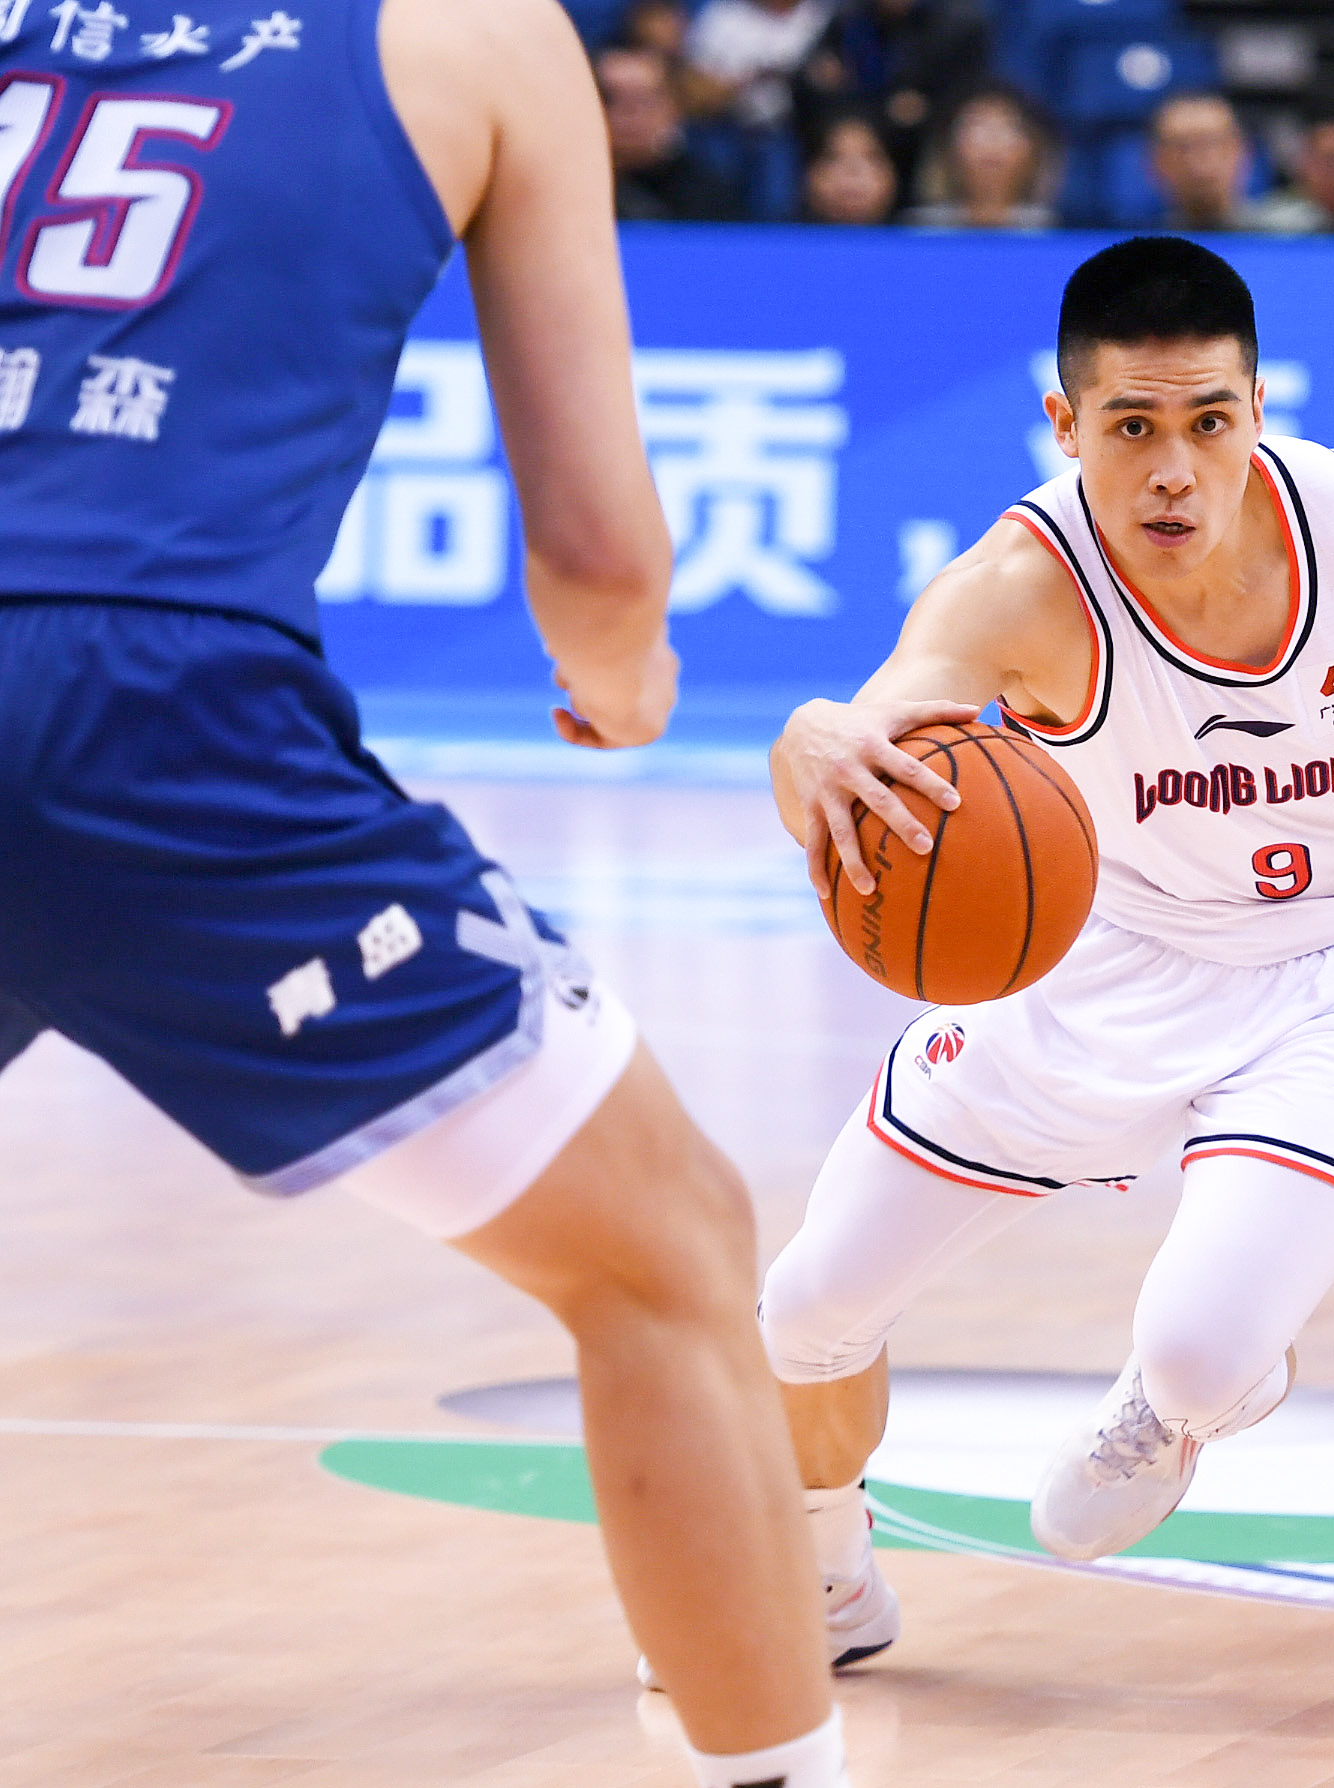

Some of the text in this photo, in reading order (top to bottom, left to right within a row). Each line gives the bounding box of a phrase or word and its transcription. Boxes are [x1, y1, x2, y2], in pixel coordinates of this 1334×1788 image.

[0, 70, 234, 310] 15
[1134, 763, 1257, 824] LOONG
[1251, 842, 1313, 899] 9
